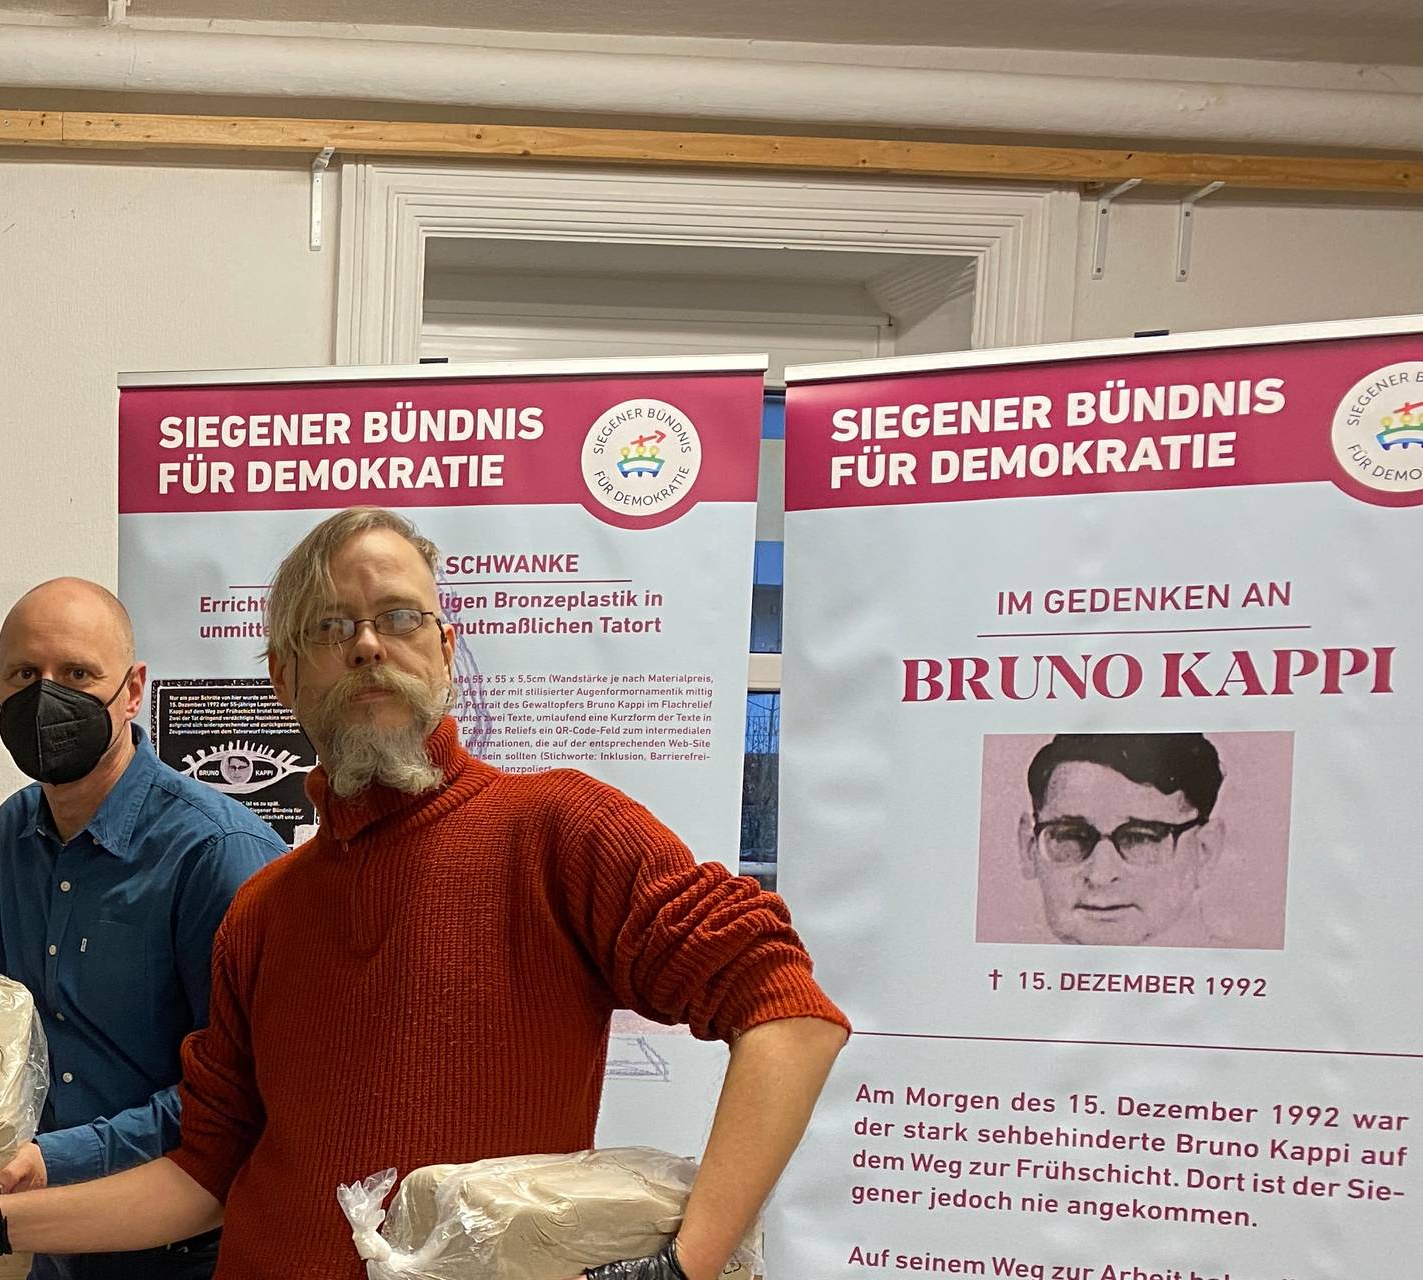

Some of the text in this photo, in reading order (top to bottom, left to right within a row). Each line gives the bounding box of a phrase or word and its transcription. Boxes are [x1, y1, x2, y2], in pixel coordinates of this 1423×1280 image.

[831, 377, 1285, 442] SIEGENER BÜNDNIS
[1347, 371, 1410, 426] SIEGENER
[158, 402, 544, 448] SIEGENER BÜNDNIS
[593, 408, 692, 454] SIEGENER BÜNDNIS
[159, 453, 504, 494] FÜR DEMOKRATIE
[831, 431, 1236, 489] FÜR DEMOKRATIE
[1348, 444, 1423, 481] FÜR DEMO
[594, 466, 690, 506] FÜR DEMOKRATIE
[445, 554, 579, 575] SCHWANKE
[200, 595, 267, 613] Erricht
[438, 590, 662, 613] ligen Bronzeplastik in
[998, 581, 1291, 615] IM GEDENKEN AN
[200, 621, 270, 638] unmitte
[599, 616, 661, 633] Tatort
[472, 674, 483, 684] 55
[487, 676, 493, 684] x
[495, 674, 507, 684] 55
[509, 676, 515, 684] x
[518, 674, 546, 684] 5,5cm
[548, 674, 608, 684] (Wandstärke
[610, 674, 620, 685] je
[622, 674, 645, 684] nach
[648, 674, 713, 685] Materialpreis,
[901, 646, 1395, 702] BRUNO KAPPI
[463, 687, 477, 697] die
[479, 687, 488, 697] in
[490, 687, 506, 697] der
[508, 687, 523, 697] mit
[525, 687, 574, 697] stilisierter
[576, 687, 684, 698] Augenformornamentik
[686, 687, 713, 698] mittig
[466, 700, 501, 710] Portrait
[503, 700, 520, 710] des
[522, 700, 585, 712] Gewaltopfers
[587, 700, 616, 710] Bruno
[618, 700, 645, 711] Kappi
[648, 700, 659, 710] im
[662, 699, 713, 709] Flachrelief
[462, 725, 484, 735] Ecke
[487, 725, 503, 735] des
[505, 725, 537, 735] Reliefs
[539, 725, 554, 735] ein
[556, 725, 621, 736] QR-Code-Feld
[623, 727, 644, 735] zum
[646, 725, 712, 735] intermedialen
[485, 712, 505, 722] zwei
[508, 712, 536, 723] Texte,
[537, 712, 587, 722] umlaufend
[589, 712, 609, 722] eine
[611, 712, 657, 722] Kurzform
[658, 712, 674, 722] der
[677, 712, 701, 722] Texte
[703, 712, 712, 722] in
[465, 738, 710, 749] Informationen, die auf der entsprechenden Web-Site
[482, 751, 502, 760] sein
[505, 751, 537, 760] sollten
[540, 751, 598, 761] (Stichworte:
[600, 751, 647, 761] Inklusion,
[650, 751, 711, 760] Barrierefrei-
[198, 769, 274, 777] BRUNO KAPPI
[1019, 971, 1052, 990] 15.
[1060, 972, 1195, 994] DEZEMBER
[1206, 977, 1266, 997] 1992
[855, 1083, 1409, 1131] Am Morgen des 15. Dezember 1992 war
[854, 1116, 1407, 1167] der stark sehbehinderte Bruno Kappi auf
[852, 1149, 1405, 1201] dem Weg zur Frühschicht. Dort ist der Sie-
[851, 1185, 1257, 1227] gener jedoch nie angekommen.
[848, 1246, 890, 1267] Auf
[896, 1254, 985, 1275] seinem
[992, 1257, 1045, 1280] Weg
[1051, 1266, 1095, 1280] zur
